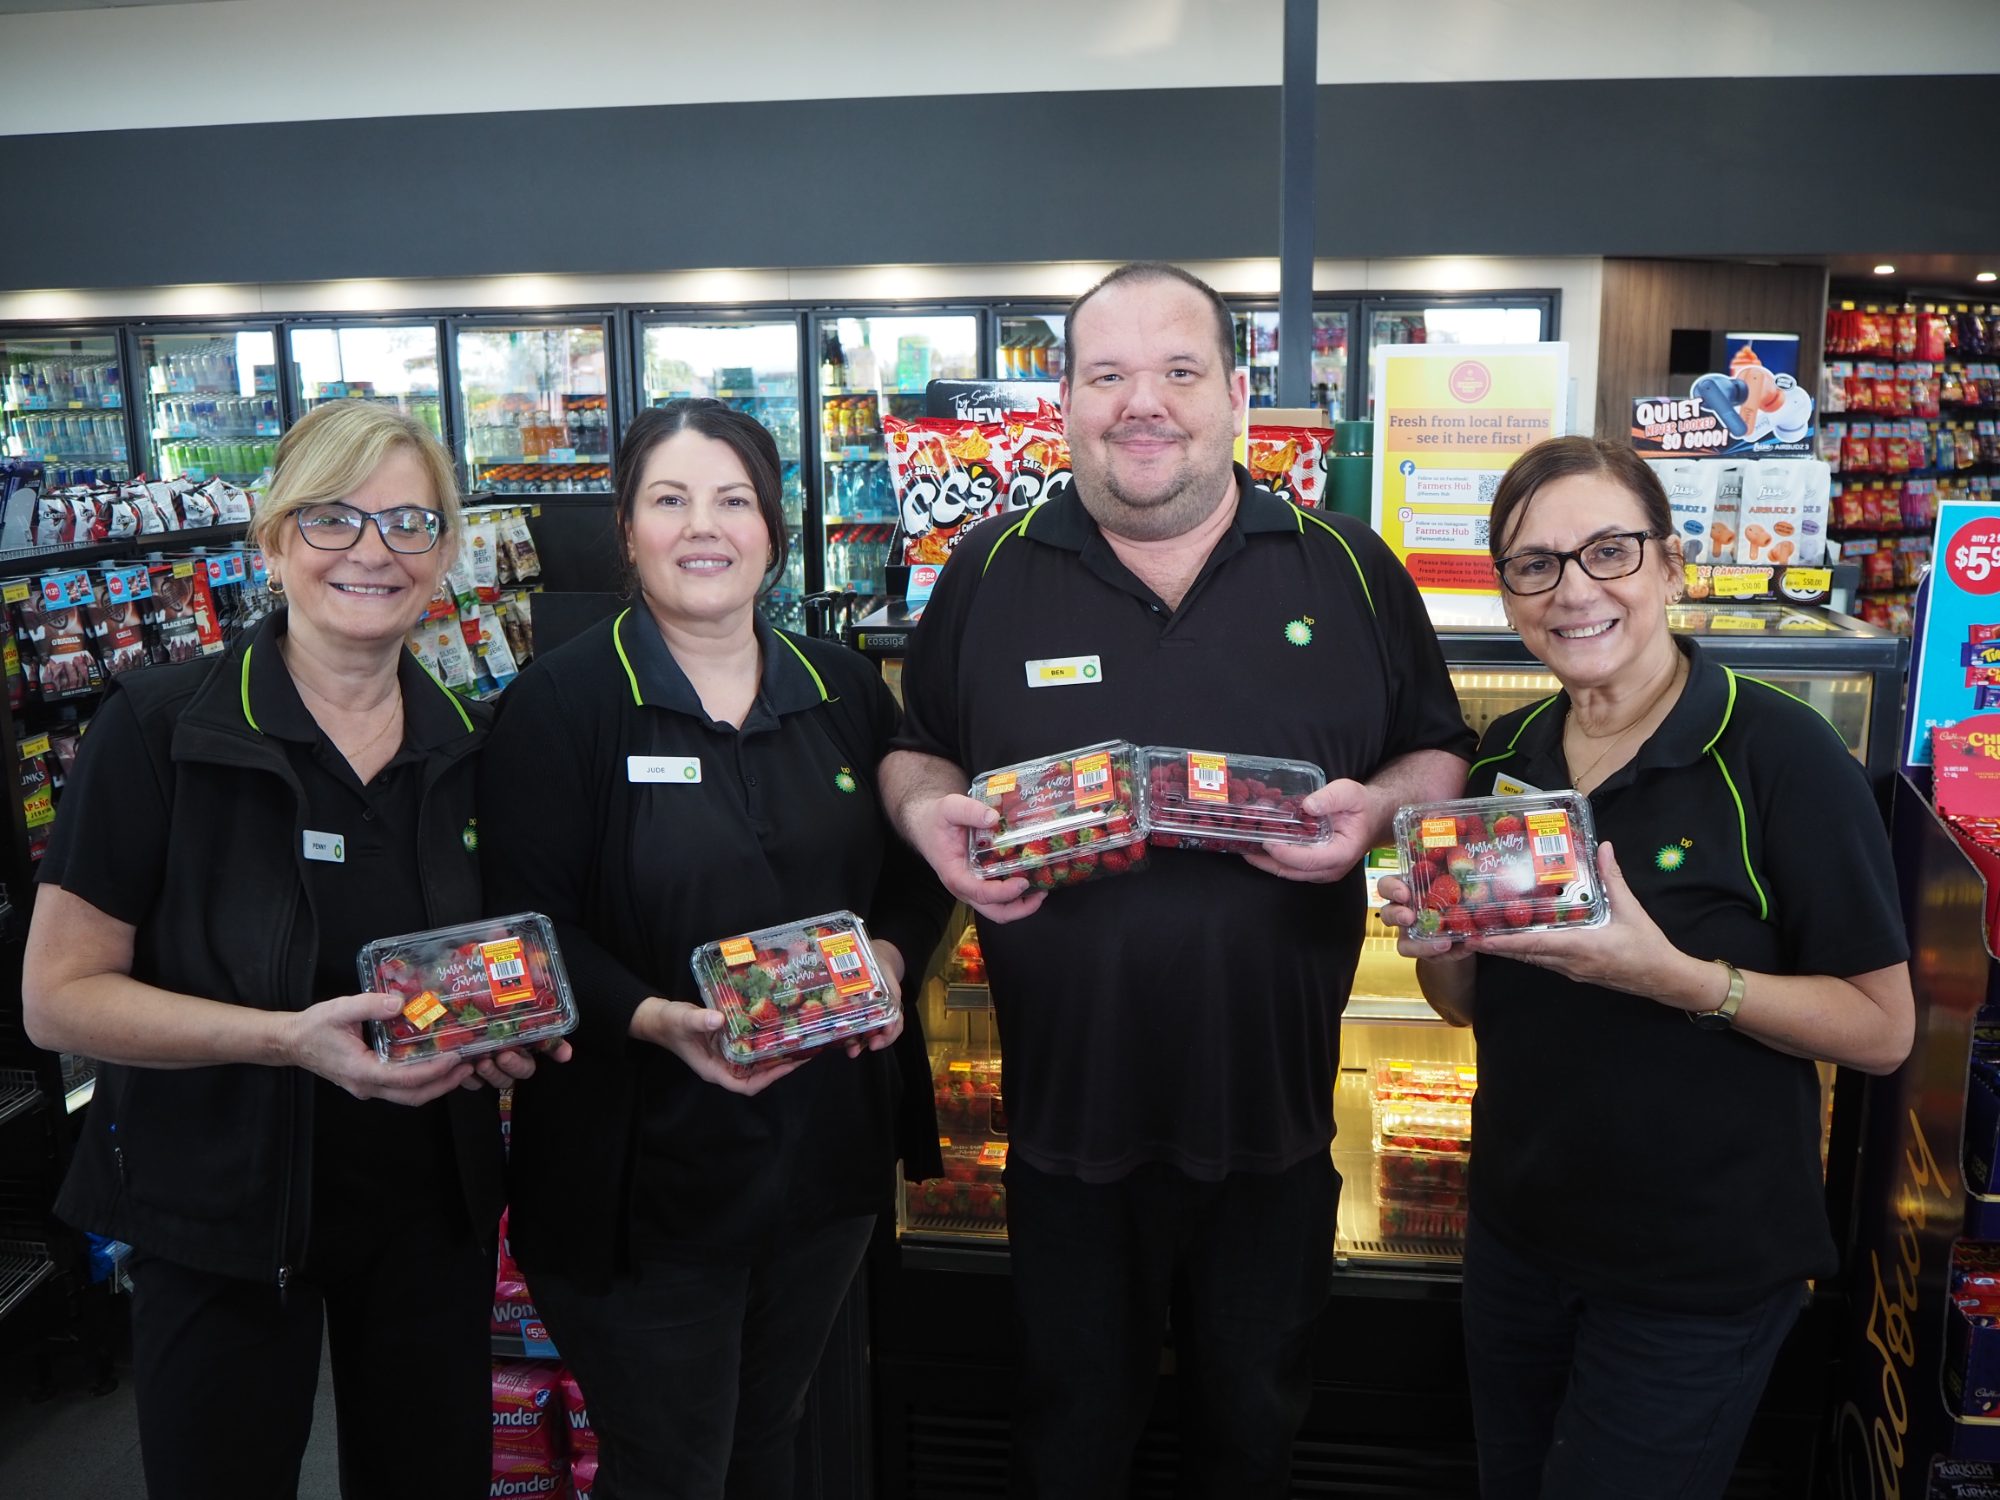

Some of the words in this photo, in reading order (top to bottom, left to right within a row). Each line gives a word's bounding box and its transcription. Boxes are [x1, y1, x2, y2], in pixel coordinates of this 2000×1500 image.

[949, 393, 970, 411] Try
[957, 407, 1010, 424] NEW
[1636, 398, 1703, 426] QUIET
[1389, 415, 1427, 428] Fresh
[1431, 415, 1466, 428] from
[1469, 415, 1502, 428] local
[1506, 415, 1549, 428] farms
[1645, 421, 1678, 437] NEVER
[1678, 416, 1717, 433] LOOKED
[1416, 434, 1439, 444] see
[1442, 432, 1453, 444] it
[1457, 432, 1488, 444] here
[1492, 432, 1522, 444] first
[1526, 432, 1531, 444] !
[1662, 433, 1683, 450] SO
[1684, 429, 1729, 449] GOOD!
[1417, 482, 1452, 490] Farmers
[1454, 482, 1472, 490] Hub
[1719, 482, 1740, 499] fus
[1756, 483, 1787, 500] fuse
[1671, 505, 1700, 513] RBUDZ
[1748, 505, 1788, 514] AIRBUDZ
[1788, 505, 1796, 513] 3
[1415, 526, 1450, 535] Farmers
[1452, 527, 1470, 536] Hub
[1971, 534, 1988, 544] any
[1989, 534, 1996, 543] 2
[1303, 615, 1314, 625] bp
[867, 636, 905, 648] cossiga
[1968, 732, 2000, 747] CH
[312, 842, 327, 850] PENNY
[1494, 834, 1525, 851] Valley
[1680, 837, 1693, 849] bp
[492, 1302, 537, 1323] Won
[496, 1372, 531, 1388] WHITE
[491, 1406, 543, 1426] onder
[1934, 1462, 1994, 1477] TURKISH
